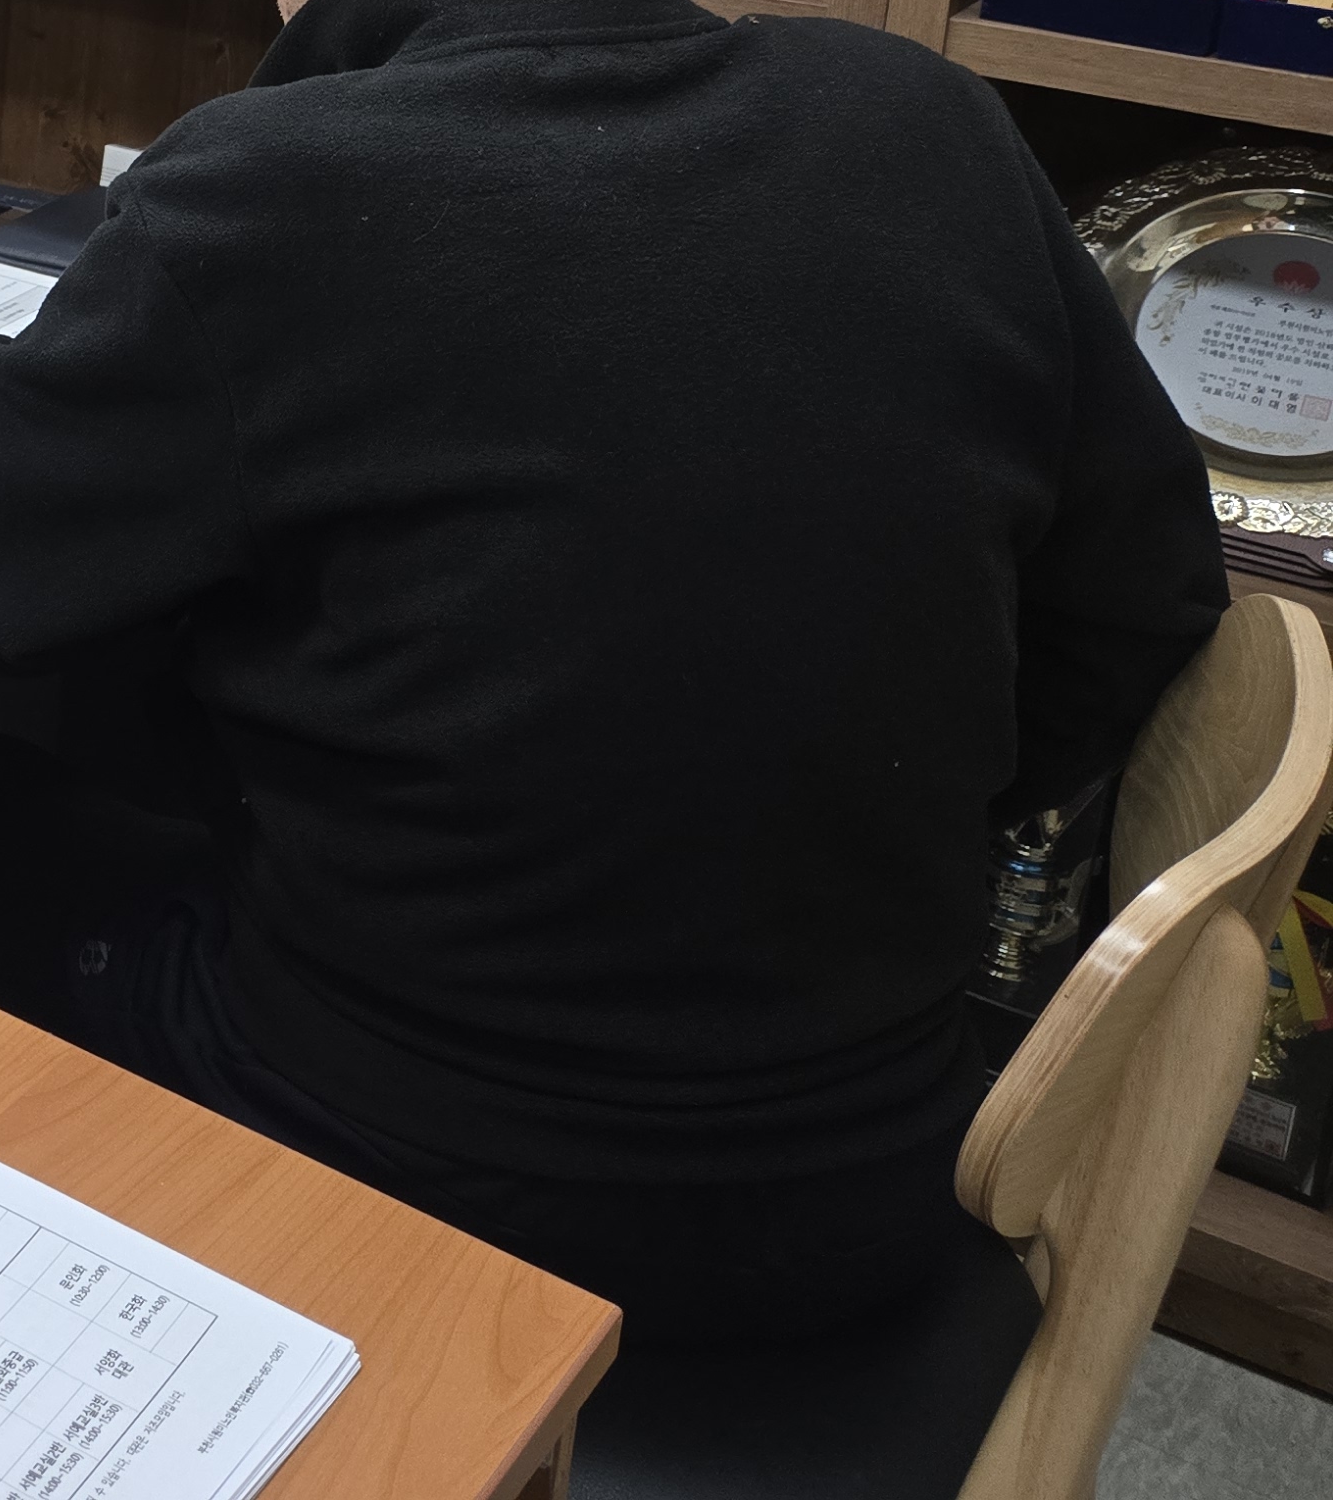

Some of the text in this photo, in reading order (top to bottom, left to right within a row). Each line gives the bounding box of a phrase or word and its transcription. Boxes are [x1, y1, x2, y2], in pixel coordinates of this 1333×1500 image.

[58, 1263, 89, 1292] 문인화
[69, 1263, 112, 1308] (10:30~12:00)
[118, 1294, 149, 1322] 한국화
[62, 1393, 110, 1443] 서예교실3반
[77, 1402, 124, 1452] (14:00~15:30)
